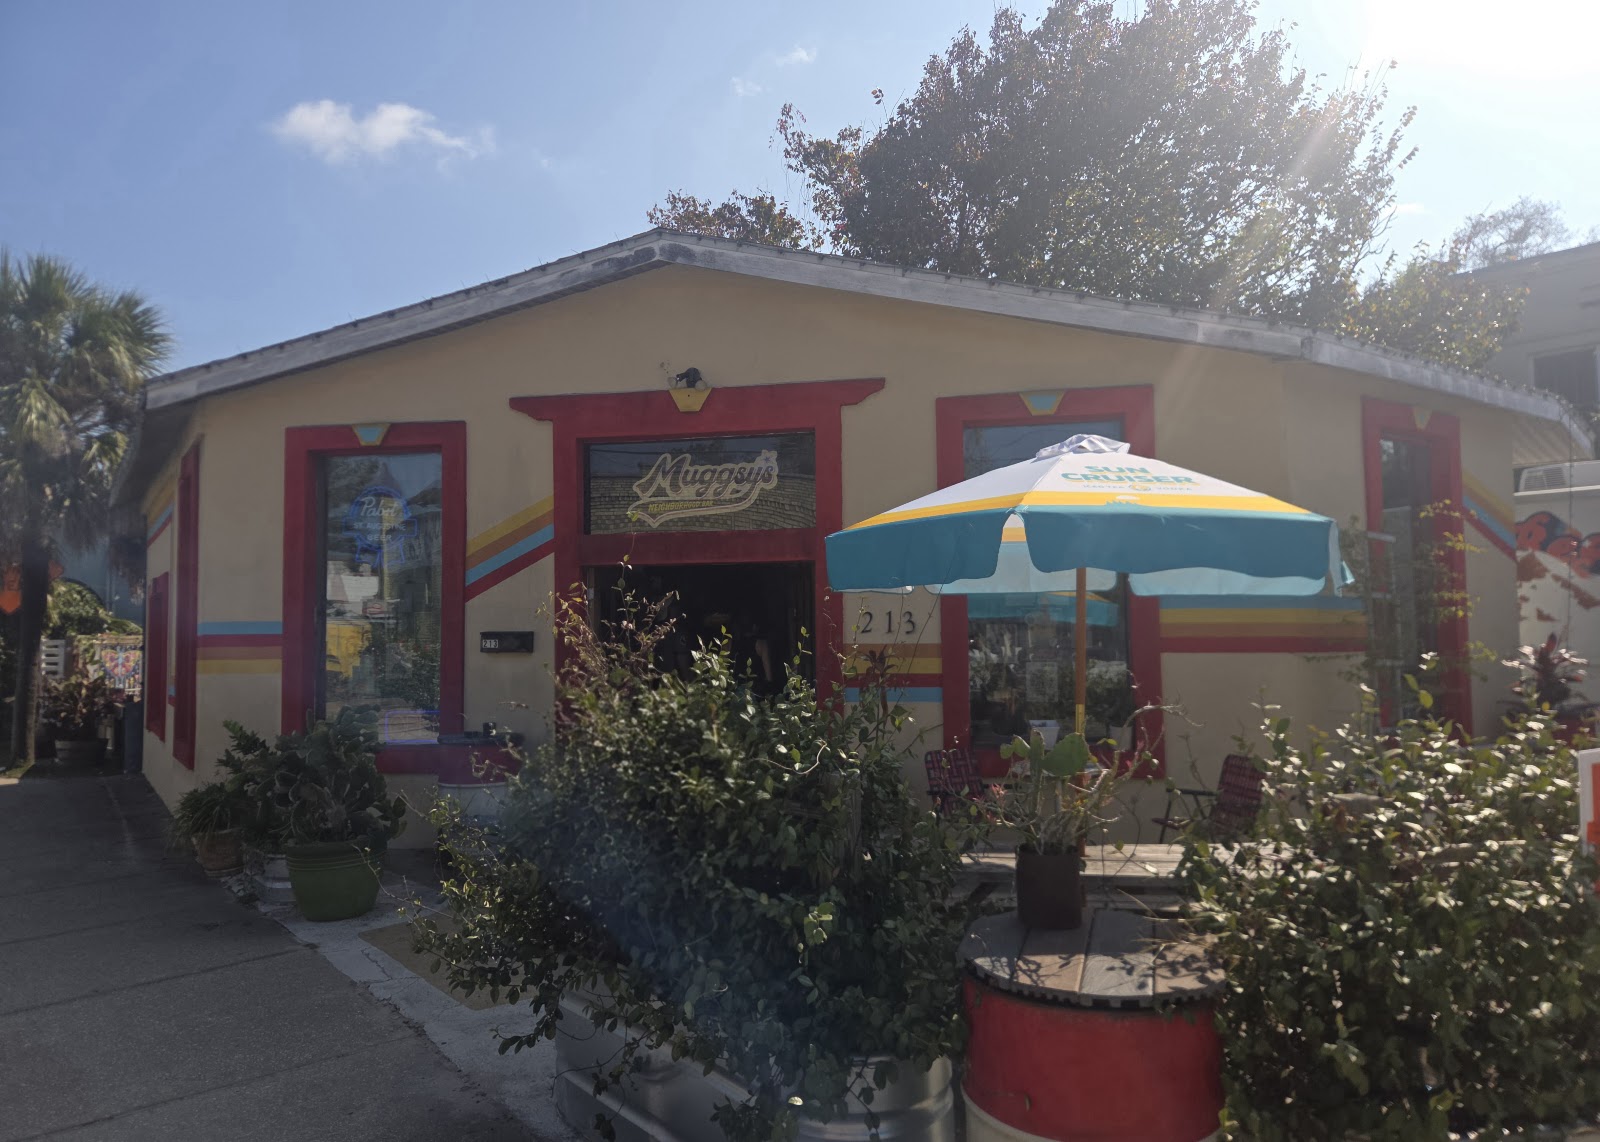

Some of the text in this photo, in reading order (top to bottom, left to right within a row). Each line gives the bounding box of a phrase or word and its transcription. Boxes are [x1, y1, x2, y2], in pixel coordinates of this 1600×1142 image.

[1084, 465, 1151, 474] SUN
[1061, 473, 1195, 484] CRUISER
[367, 534, 392, 542] BEER
[860, 612, 915, 633] 213
[482, 640, 498, 648] 213
